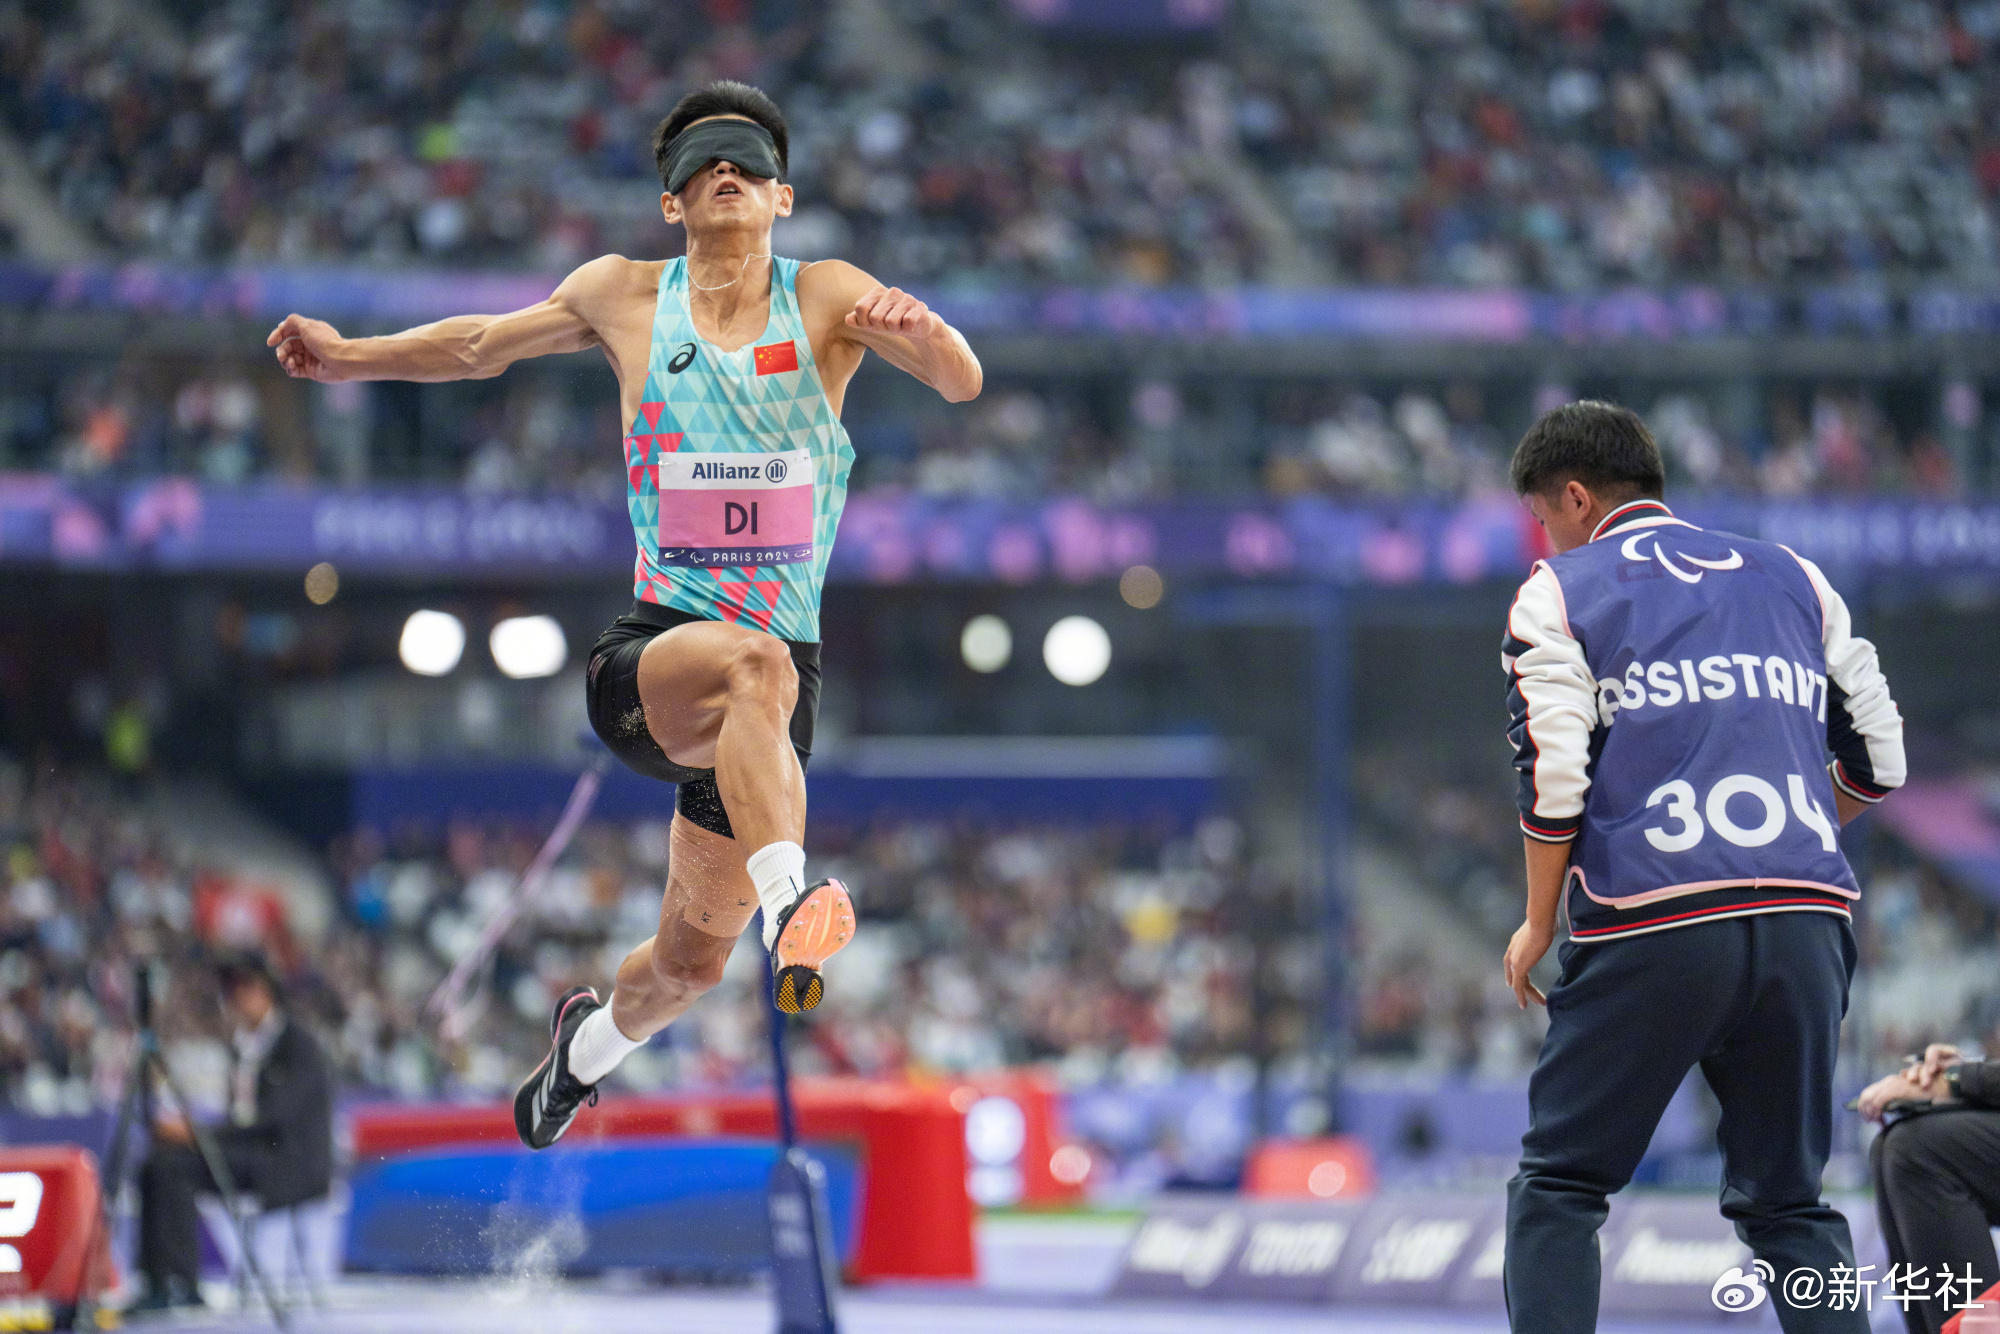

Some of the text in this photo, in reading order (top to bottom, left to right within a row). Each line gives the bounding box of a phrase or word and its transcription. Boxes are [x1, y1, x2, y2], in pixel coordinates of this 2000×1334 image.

[691, 462, 760, 479] Allianz
[724, 501, 758, 535] DI
[756, 550, 789, 562] 2024
[1598, 653, 1828, 728] ASSISTANT
[1644, 774, 1837, 853] 304
